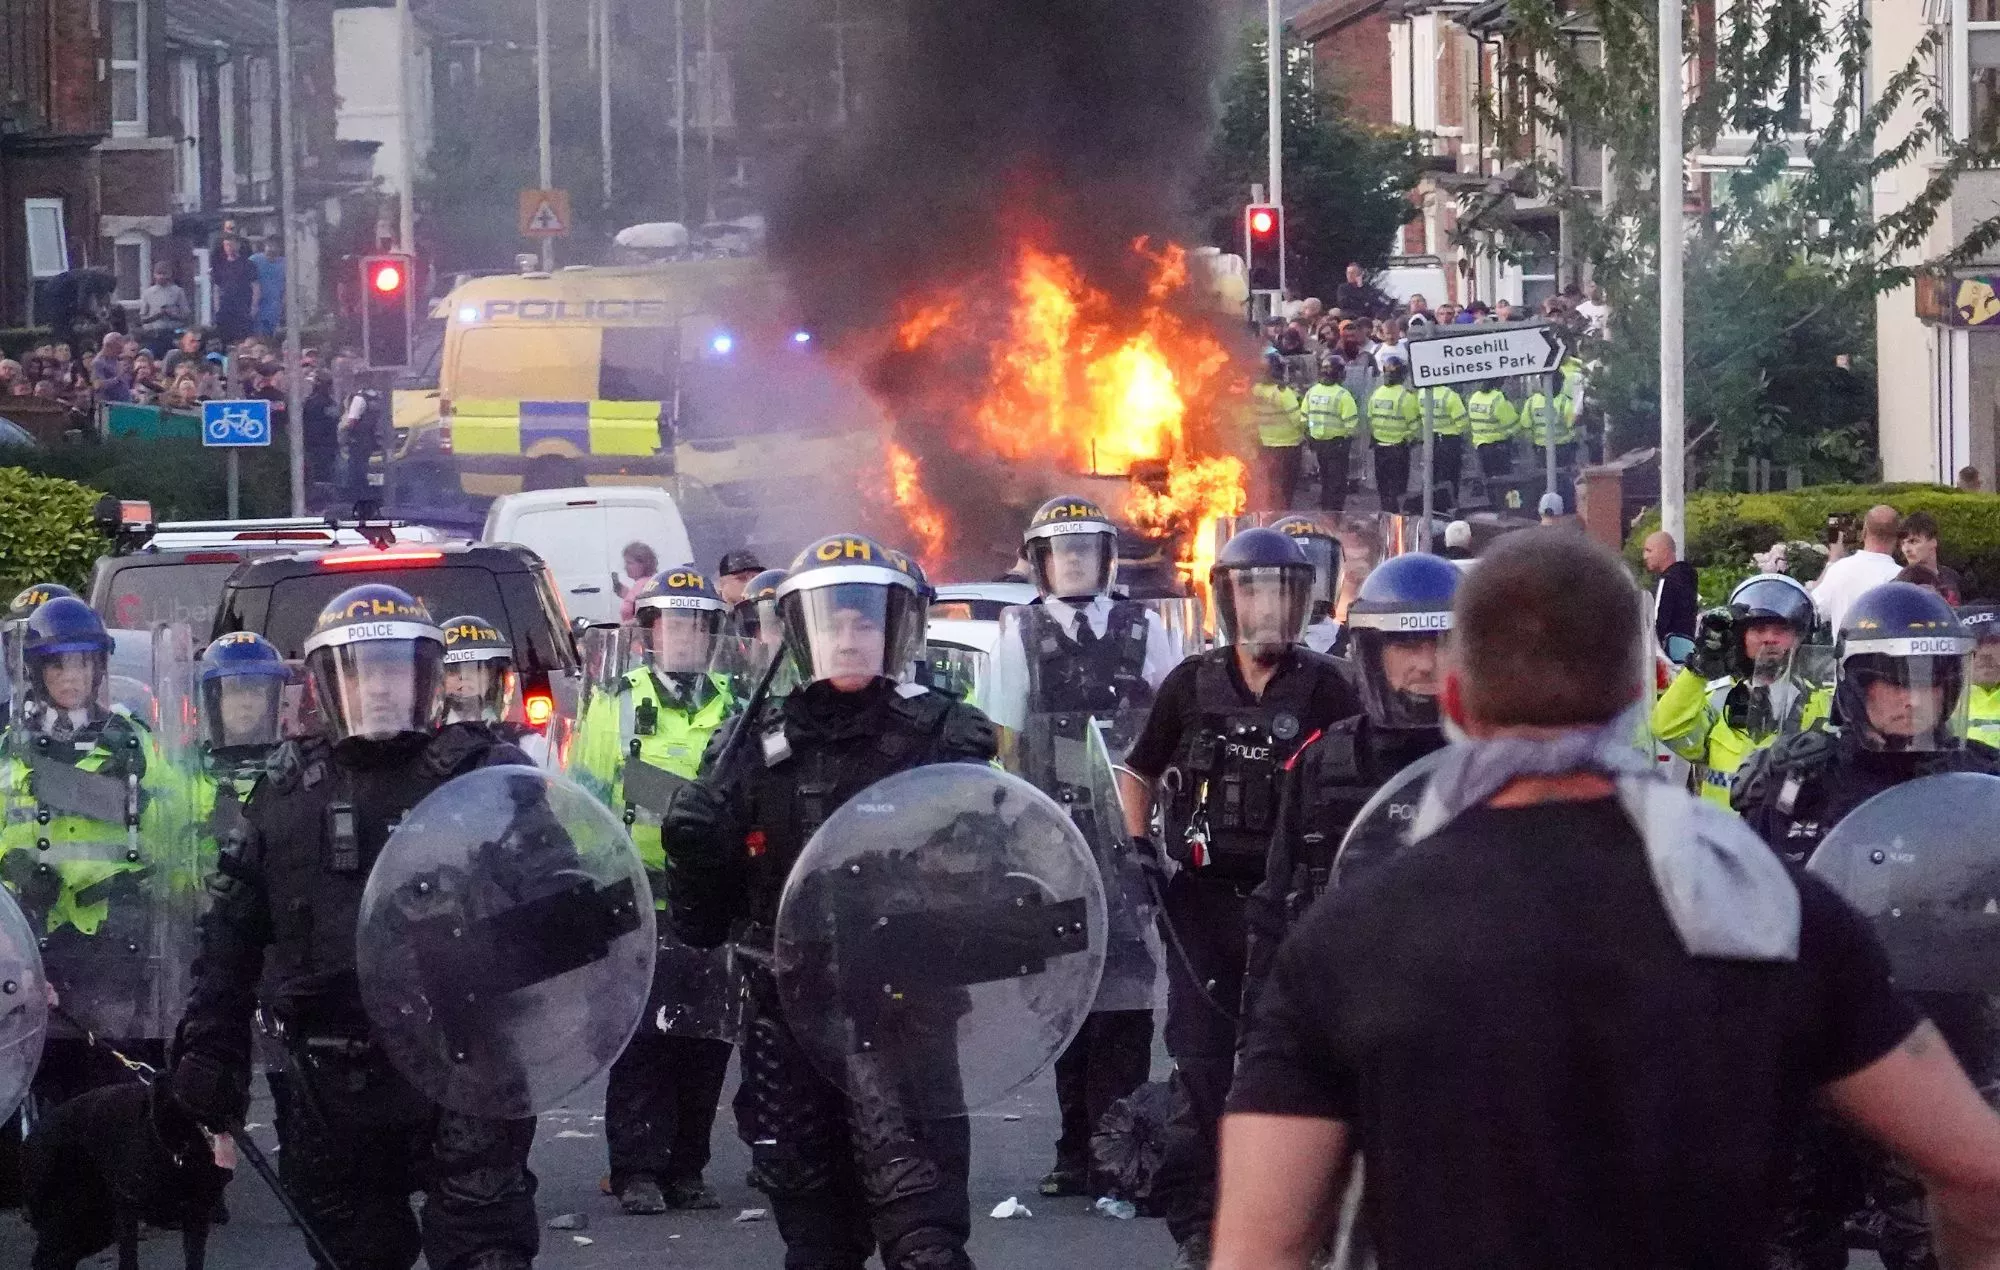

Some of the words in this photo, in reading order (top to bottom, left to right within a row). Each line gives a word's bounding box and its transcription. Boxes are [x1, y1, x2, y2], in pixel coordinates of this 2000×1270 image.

[484, 300, 668, 321] POLICE
[1443, 338, 1509, 358] Rosehill
[1420, 360, 1492, 378] Business
[1500, 353, 1536, 369] Park
[1050, 504, 1087, 519] CH
[1053, 523, 1083, 533] POLICE
[816, 539, 871, 561] CH
[668, 573, 704, 589] CH
[347, 599, 395, 617] CH
[670, 598, 700, 607] POLICE
[1401, 615, 1447, 629] POLICE
[1962, 612, 1994, 625] POLICE
[348, 624, 394, 640] POLICE
[1911, 640, 1955, 653] POLICE
[1229, 744, 1270, 761] POLICE
